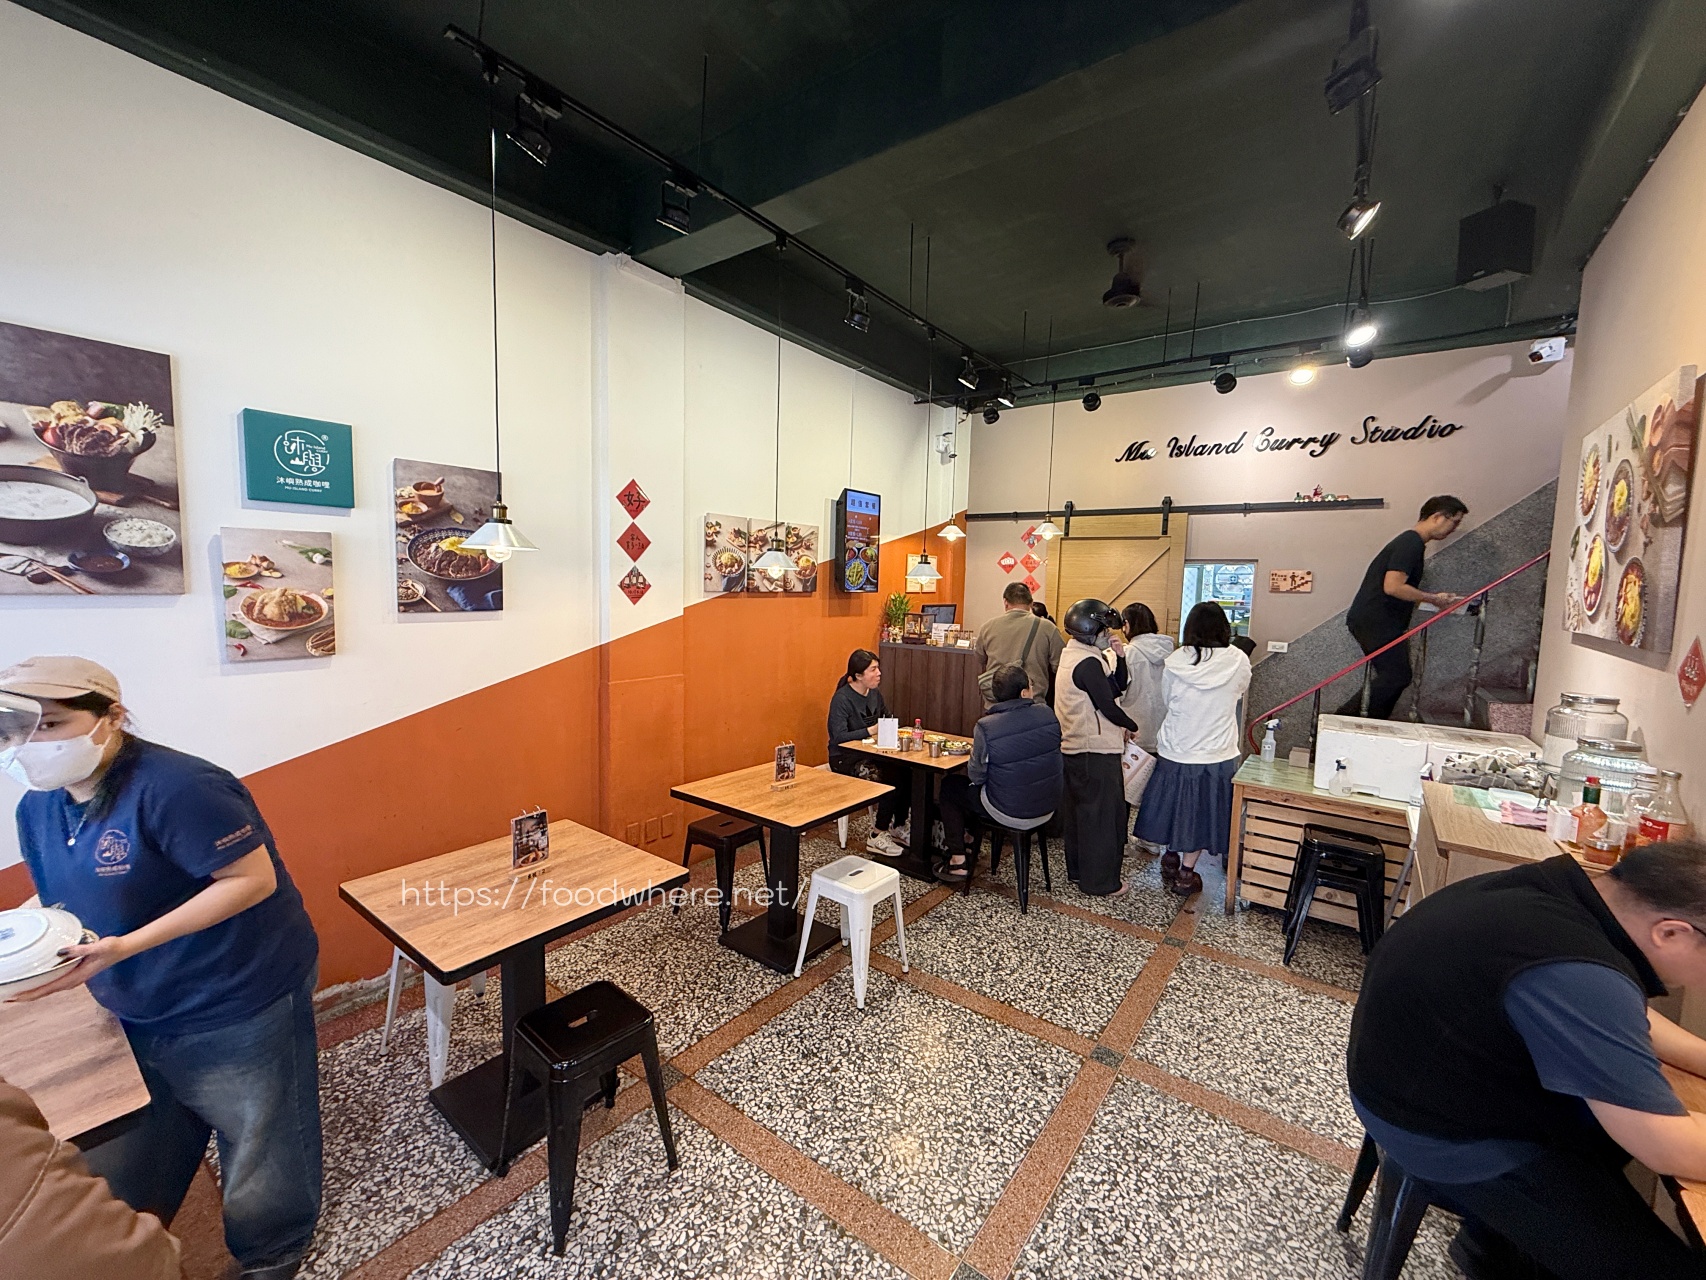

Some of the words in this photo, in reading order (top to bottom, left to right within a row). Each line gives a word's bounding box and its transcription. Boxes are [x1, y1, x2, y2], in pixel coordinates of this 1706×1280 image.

[1166, 431, 1247, 458] Island
[1253, 426, 1341, 458] Curry
[1351, 414, 1464, 446] Studio
[624, 490, 646, 510] 好
